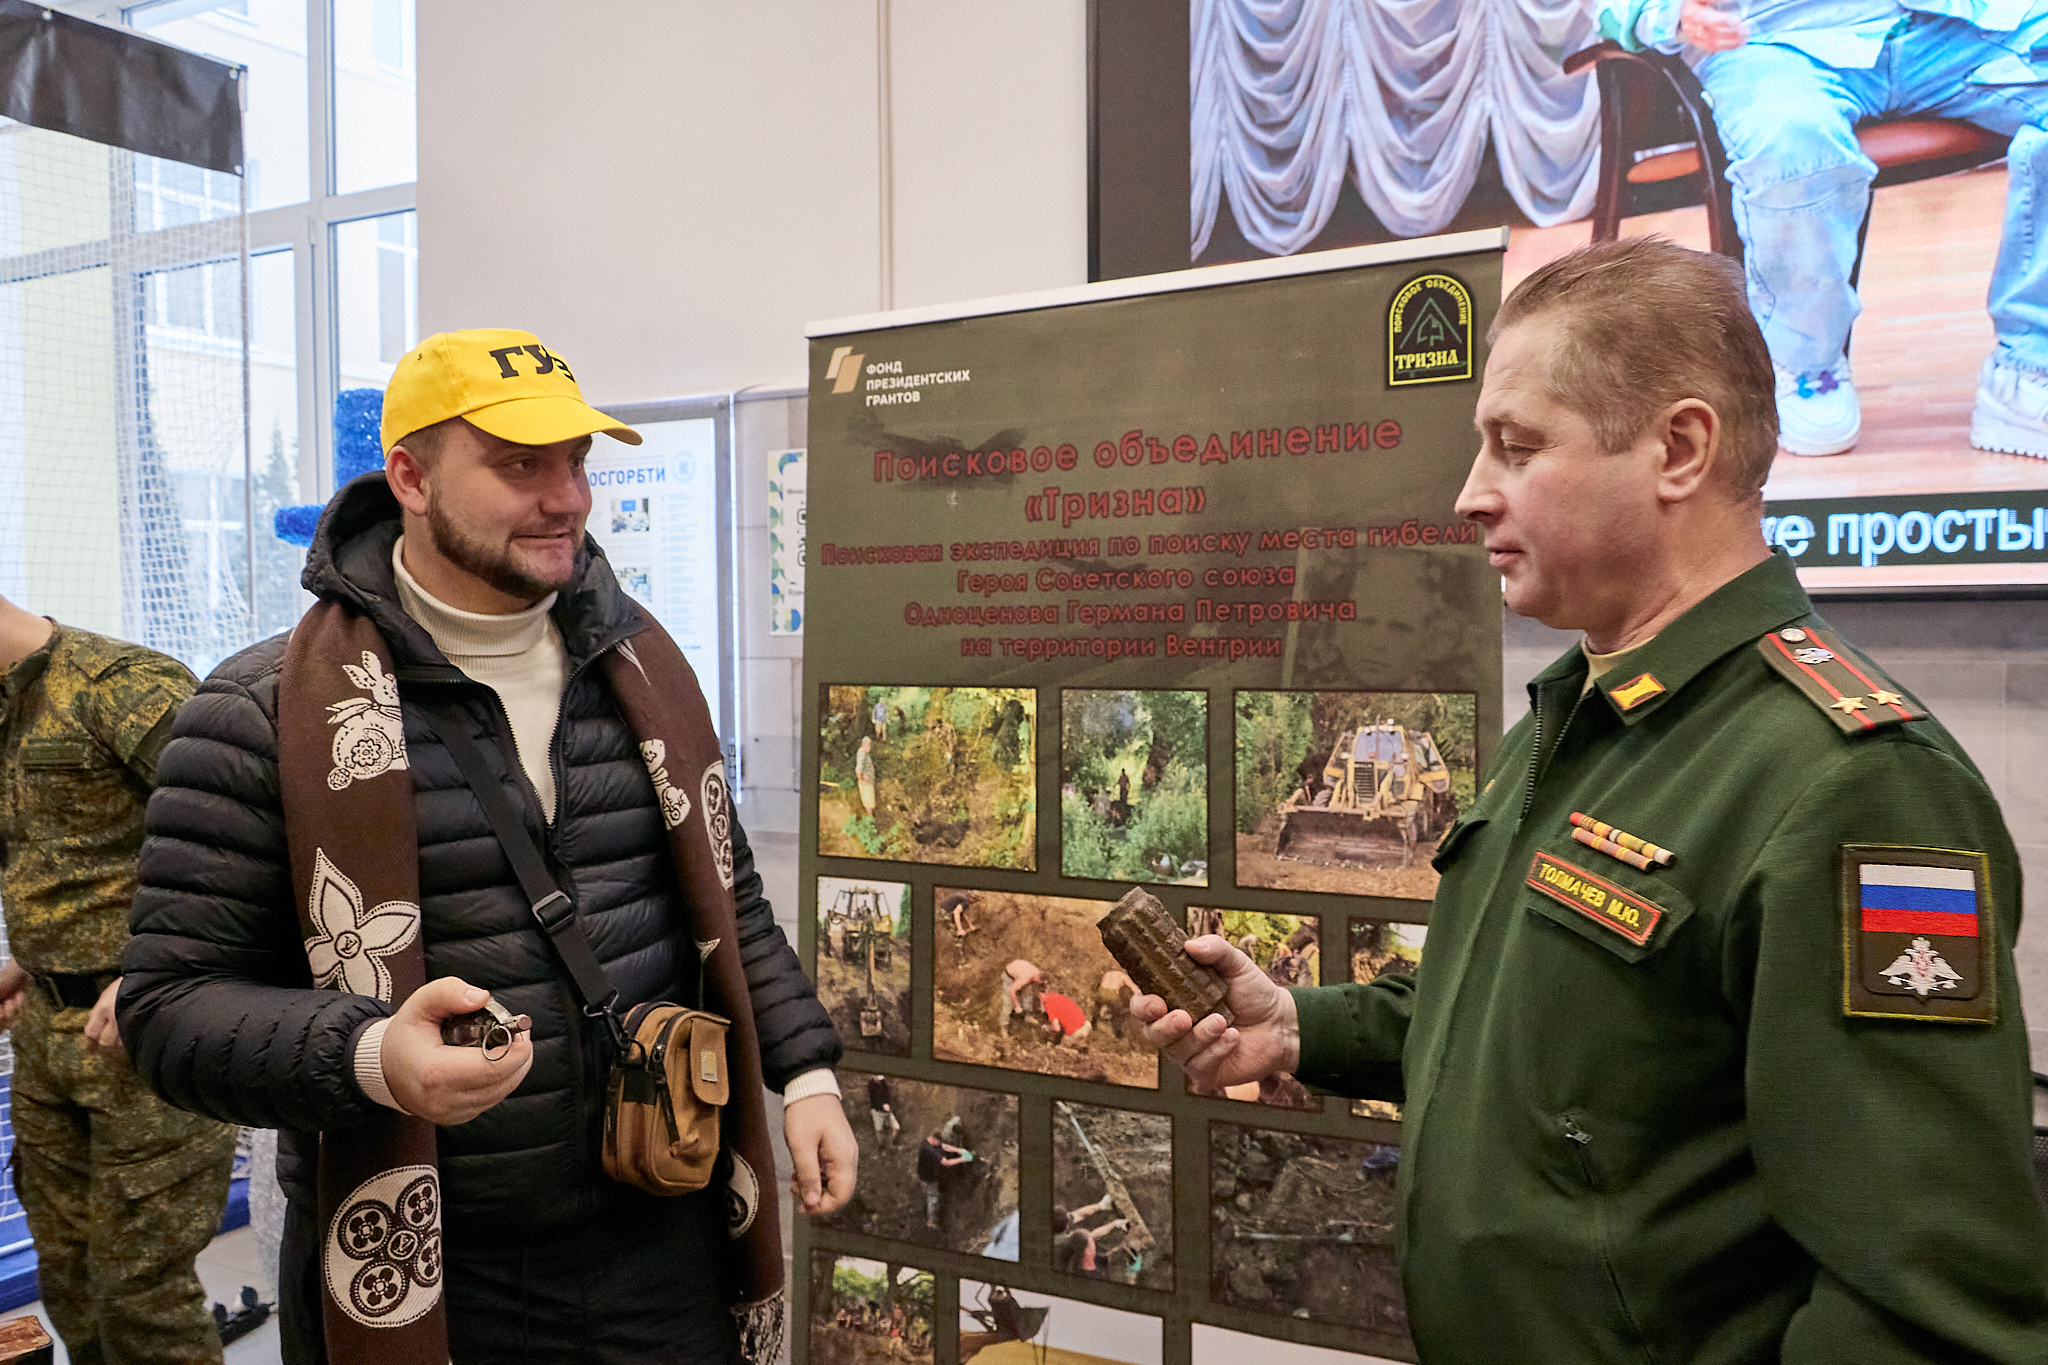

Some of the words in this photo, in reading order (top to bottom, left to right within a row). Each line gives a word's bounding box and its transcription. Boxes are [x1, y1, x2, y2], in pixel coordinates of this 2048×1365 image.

[1393, 282, 1422, 333] ПОИСКОВОЕ
[1425, 279, 1468, 325] ОБЪЕДИНЕНИЕ
[866, 360, 903, 375] ФОНД
[1394, 349, 1459, 370] ТРИЗНА
[866, 369, 971, 391] ПРЕЗИДЕНТСКИХ
[865, 391, 921, 407] ГРАНТОВ
[873, 443, 1078, 483] Поисковое
[1093, 418, 1402, 467] объединение
[588, 466, 666, 487] ОСГОРБТИ
[1025, 486, 1207, 528] «Тризна»
[820, 543, 943, 566] Поисковая
[949, 537, 1100, 562] экспедиция
[1108, 535, 1141, 556] по
[1150, 530, 1252, 559] поиску
[1260, 525, 1357, 550] места
[1366, 518, 1478, 546] гибели
[1761, 513, 1816, 558] е
[956, 569, 1029, 598] Героя
[1035, 566, 1194, 592] Советского
[1203, 564, 1296, 587] союза
[904, 601, 1060, 627] Одноценова
[1066, 599, 1185, 628] Германа
[1195, 598, 1357, 625] Петровича
[960, 637, 993, 657] на
[998, 635, 1154, 662] территории
[1164, 633, 1284, 662] Венгрии
[1538, 862, 1608, 908] ТОЛМАЧЕВ
